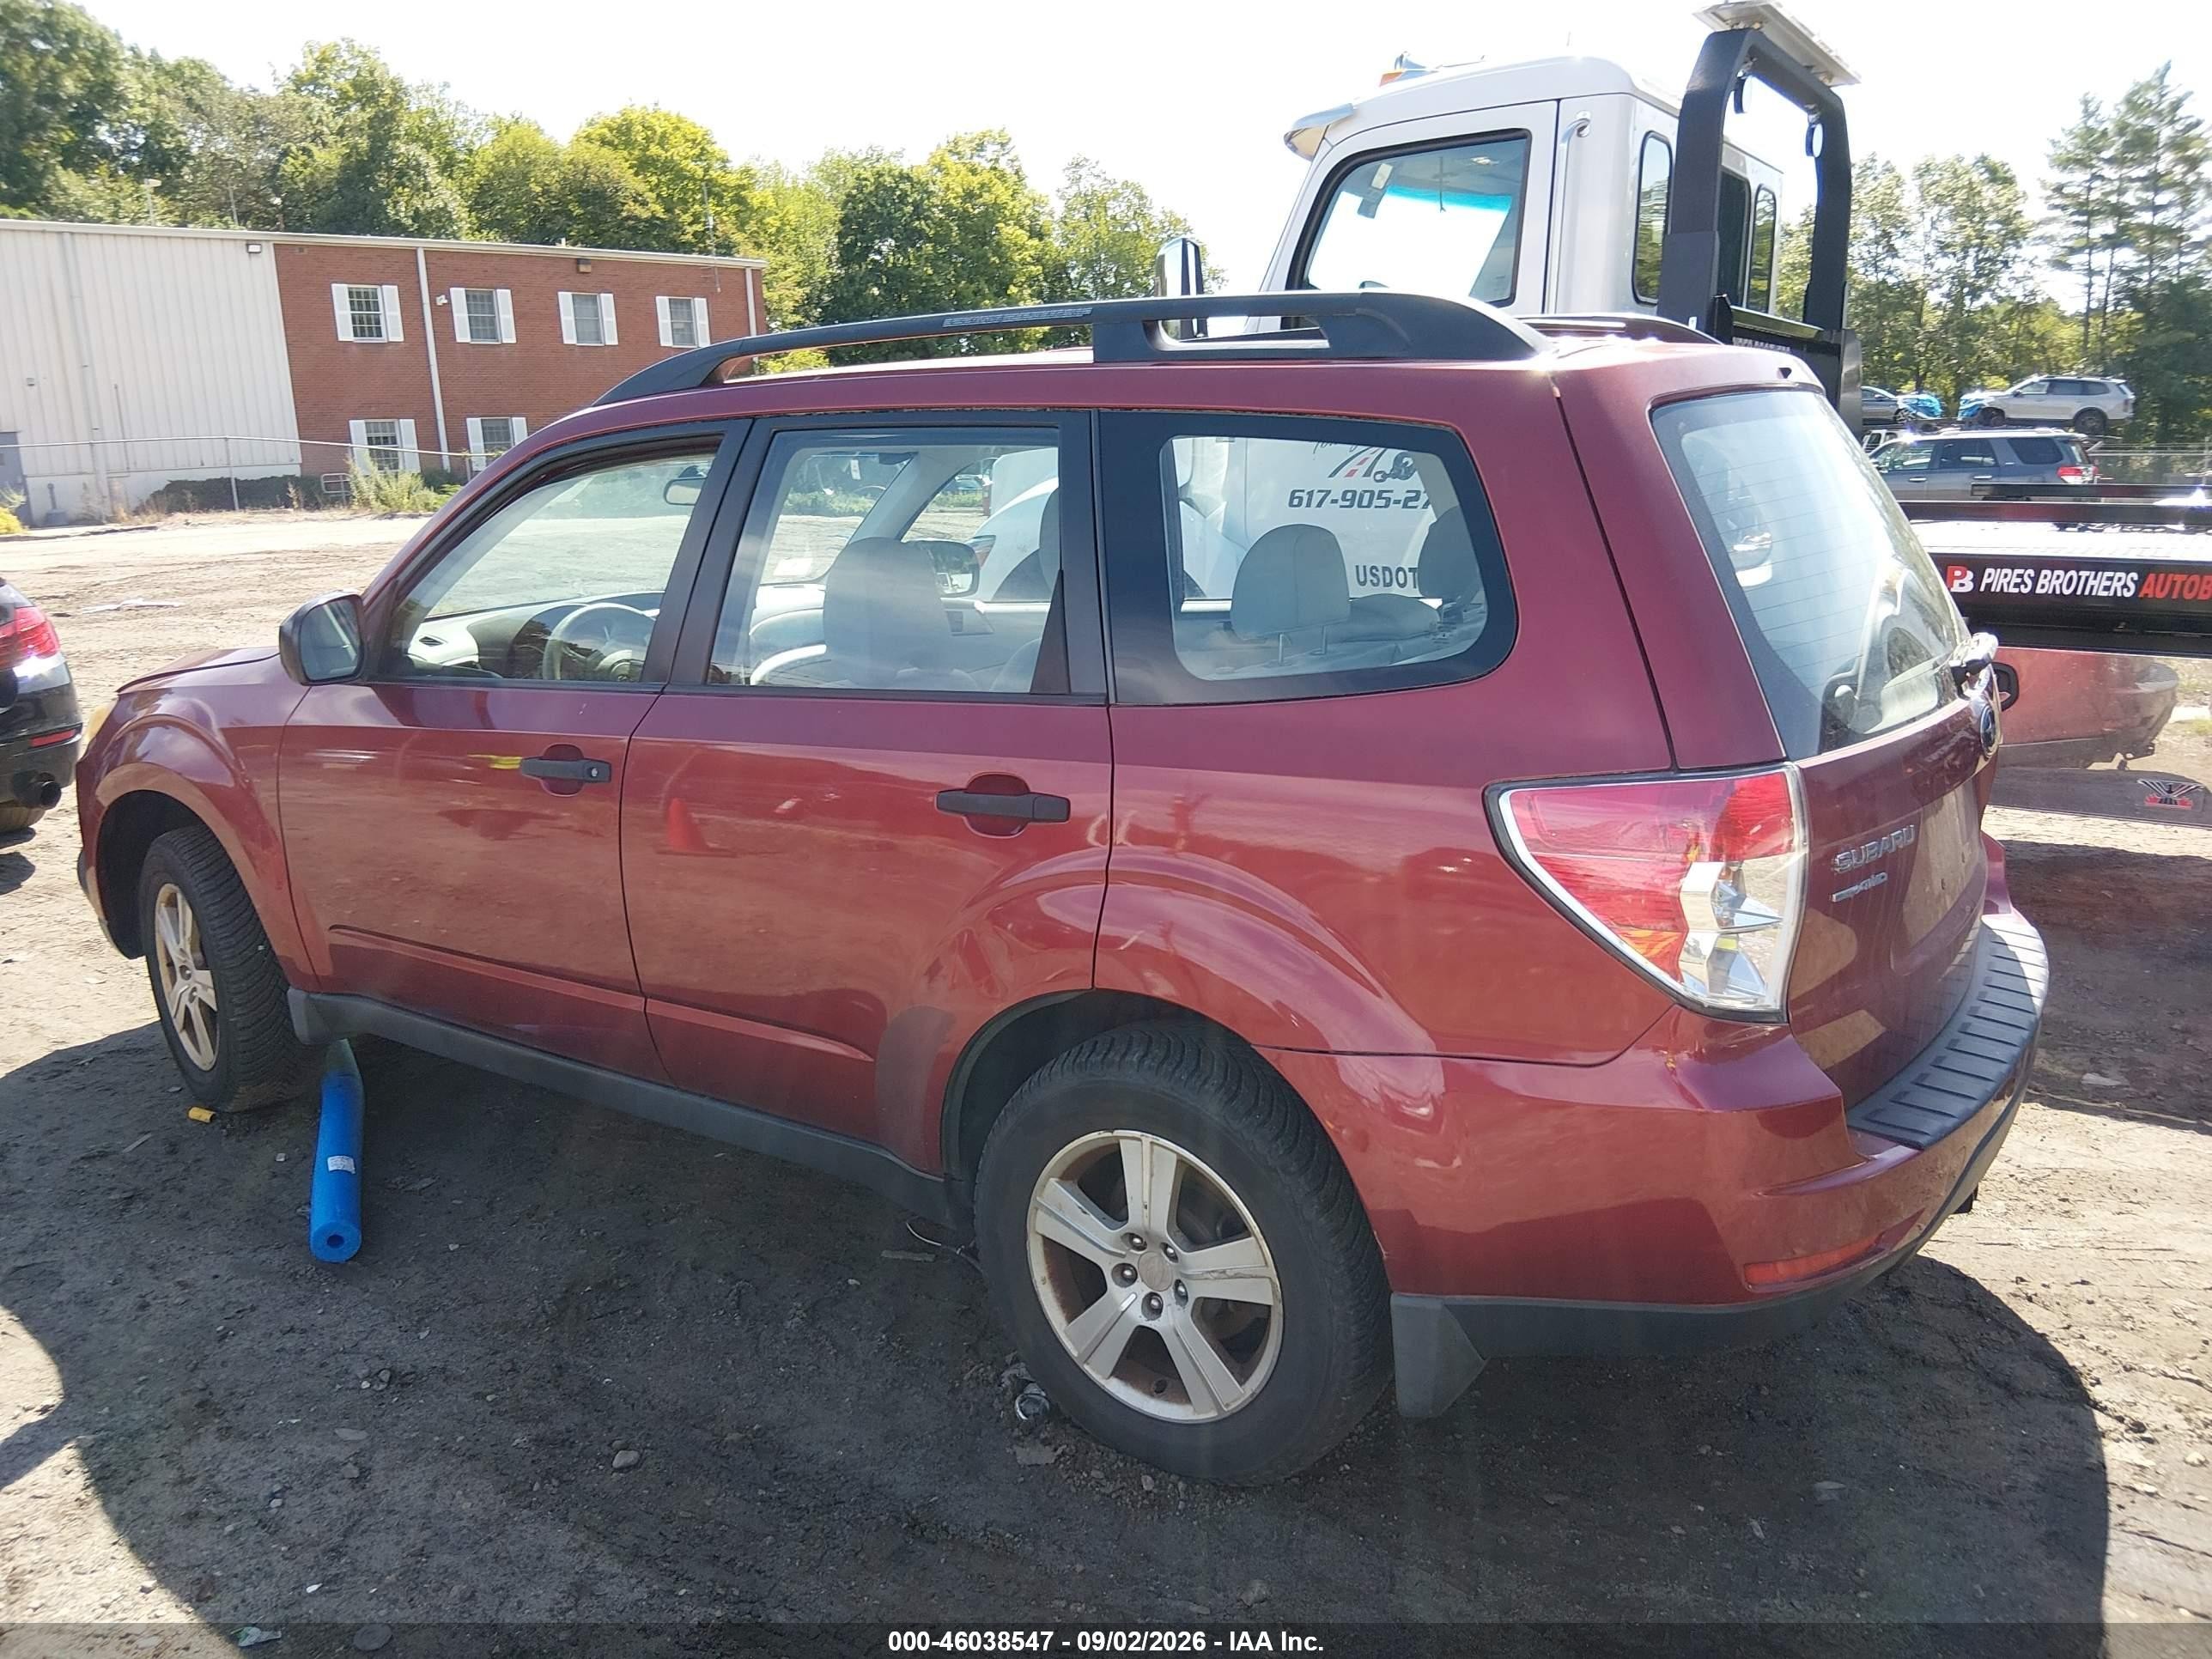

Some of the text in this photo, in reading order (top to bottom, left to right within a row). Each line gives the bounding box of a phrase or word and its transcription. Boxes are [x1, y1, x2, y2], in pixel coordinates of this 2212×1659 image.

[1355, 565, 1418, 589] USDOT
[1979, 568, 2212, 600] PIRES BROTHERS AUTOB
[1835, 824, 1915, 872] SUBARU
